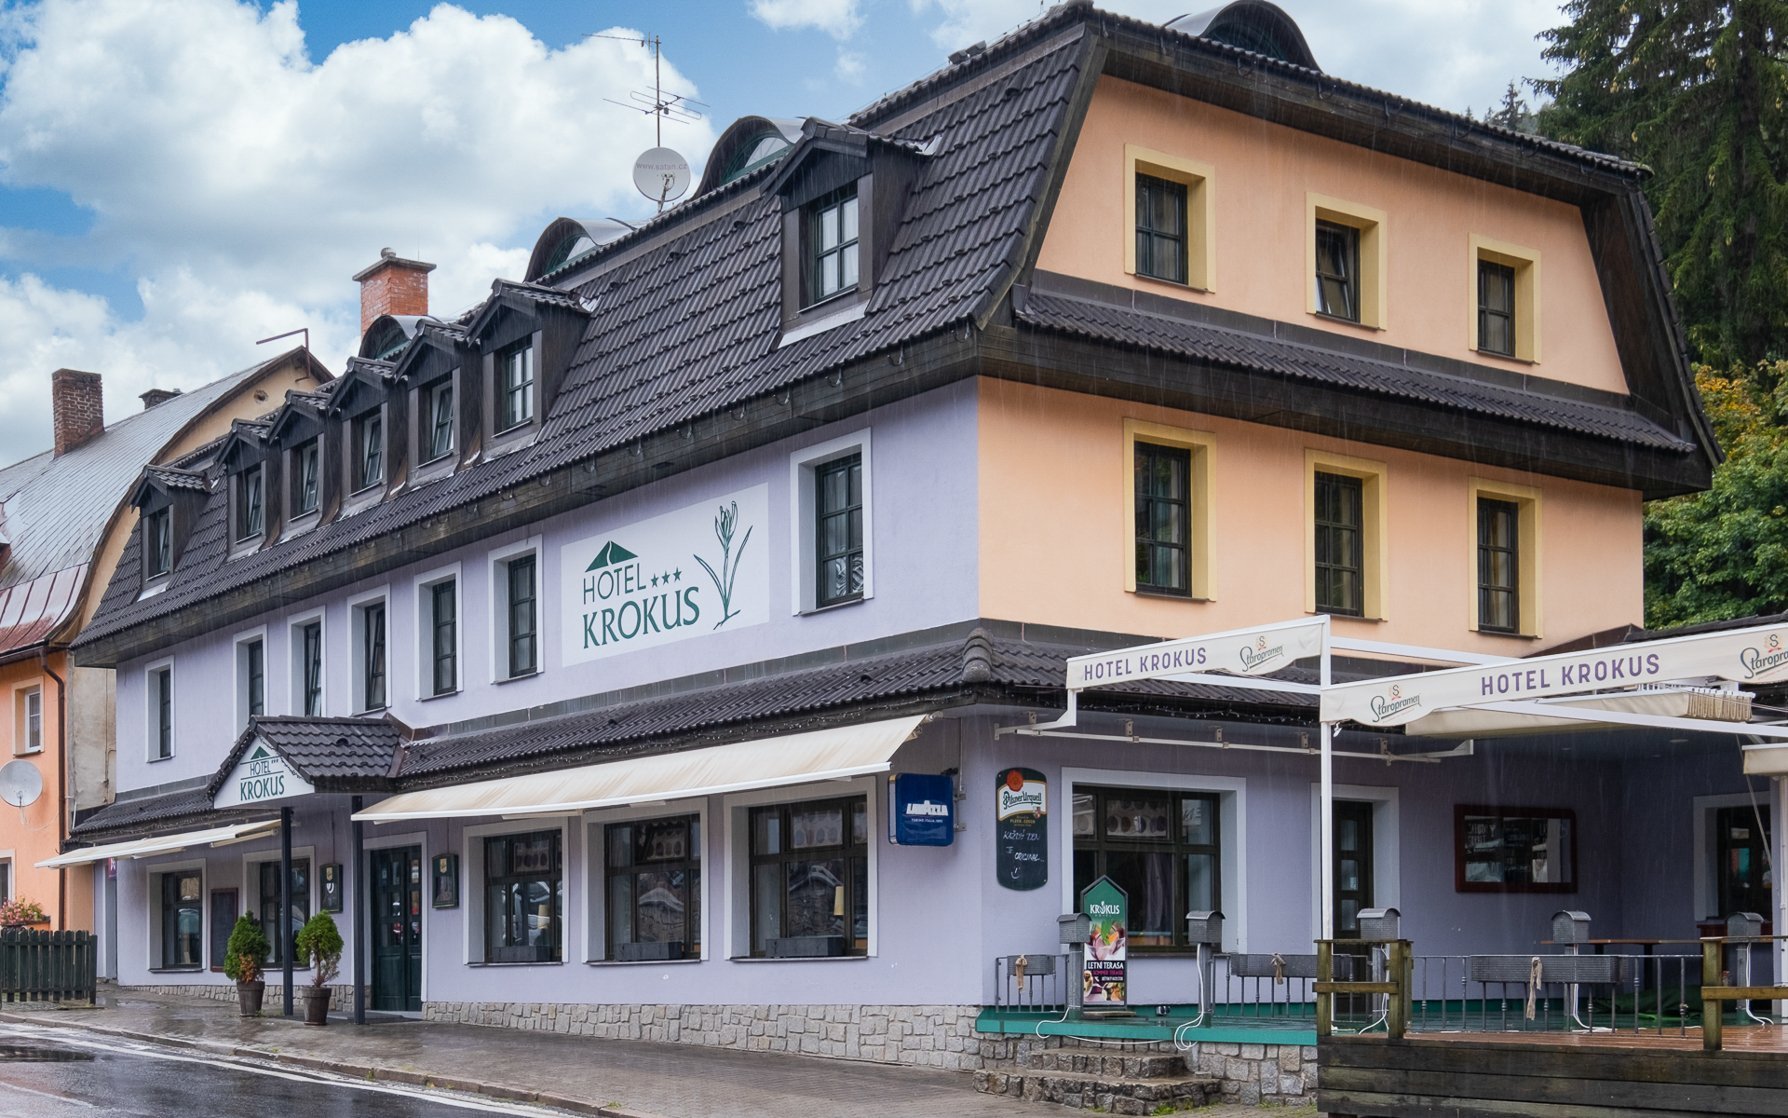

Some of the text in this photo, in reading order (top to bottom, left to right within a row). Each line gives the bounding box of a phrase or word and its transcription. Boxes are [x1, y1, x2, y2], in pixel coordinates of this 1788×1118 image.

[583, 562, 647, 605] HOTEL
[583, 586, 700, 649] KROKUS
[1084, 647, 1207, 681] HOTEL KROKUS
[1481, 653, 1660, 696] HOTEL KROKUS
[250, 760, 271, 775] HOTEL
[240, 775, 284, 800] KROKUS
[1090, 902, 1120, 914] KROKUS
